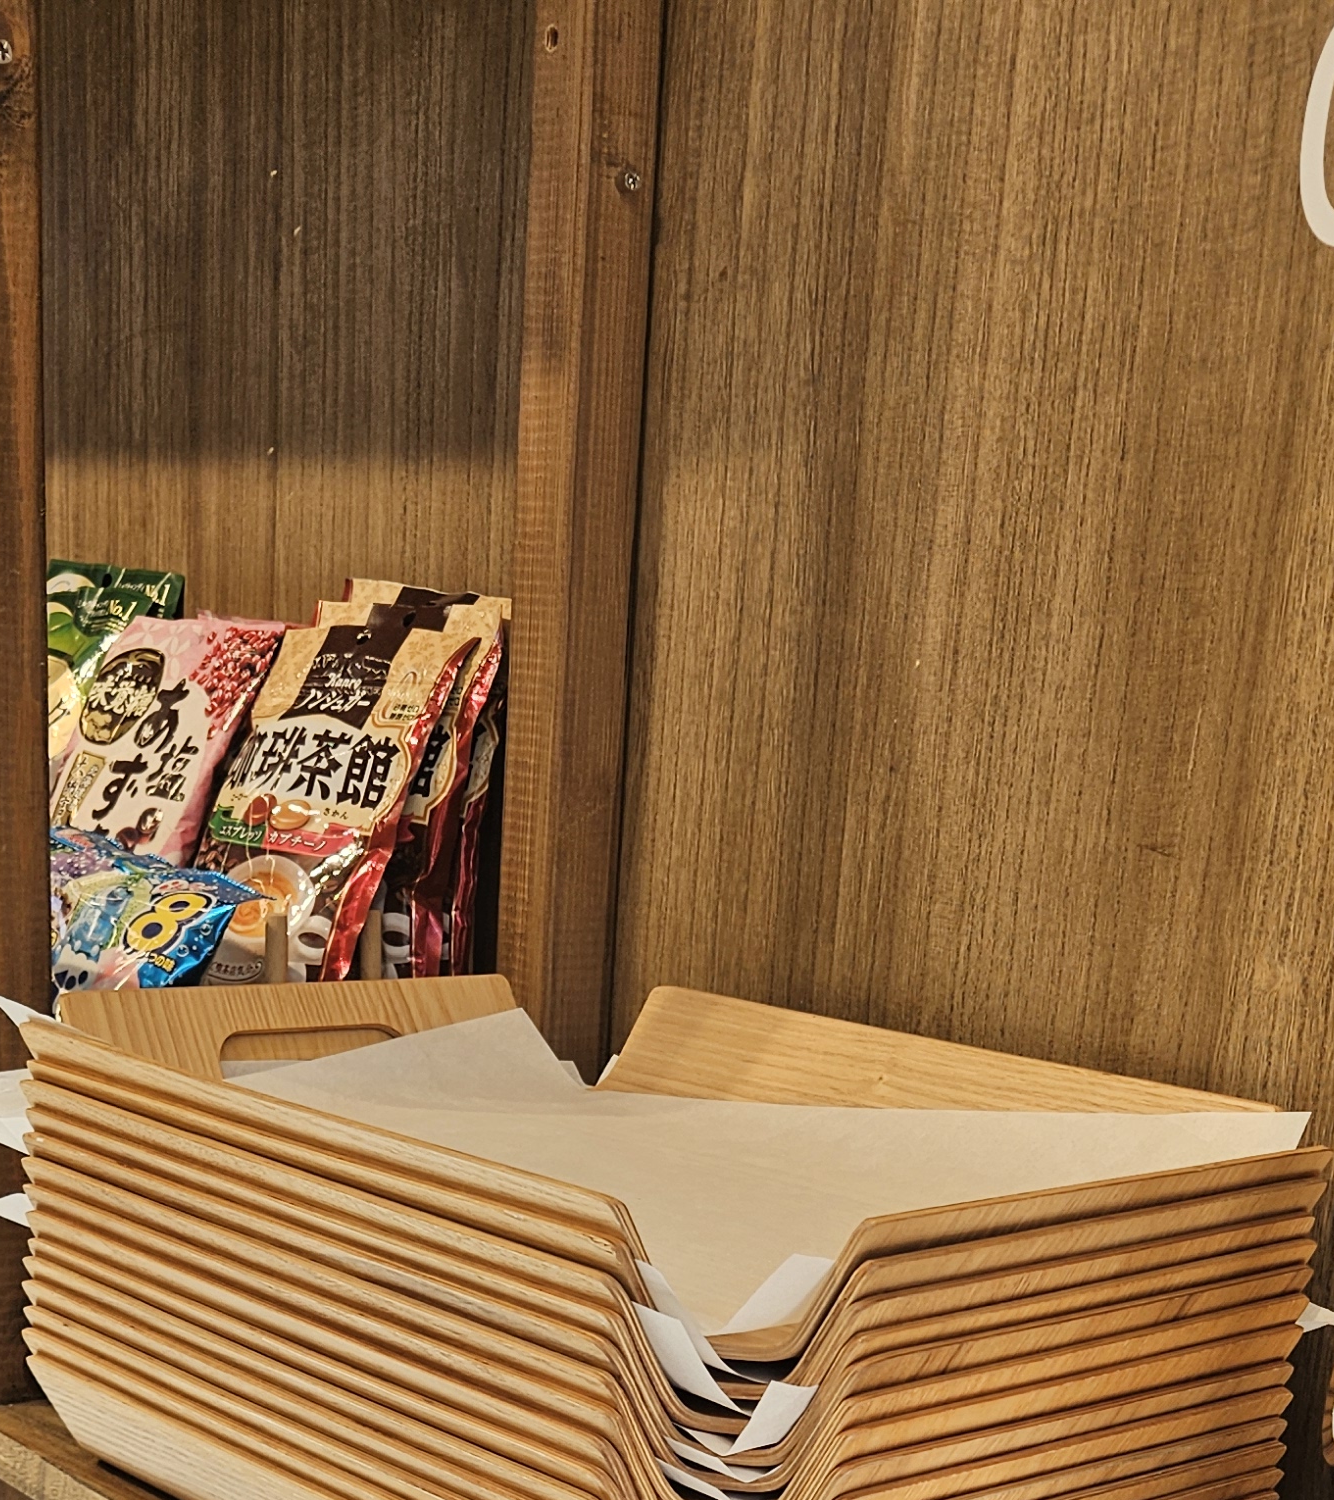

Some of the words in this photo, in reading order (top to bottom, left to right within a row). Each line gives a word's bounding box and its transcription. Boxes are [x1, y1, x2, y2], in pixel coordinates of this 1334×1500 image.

[109, 599, 138, 621] No.1
[325, 672, 362, 690] Kanro
[294, 688, 371, 713] ノンシュガー
[218, 825, 263, 843] エスプレッソ
[267, 830, 327, 851] カプチーノ
[121, 890, 219, 956] 8
